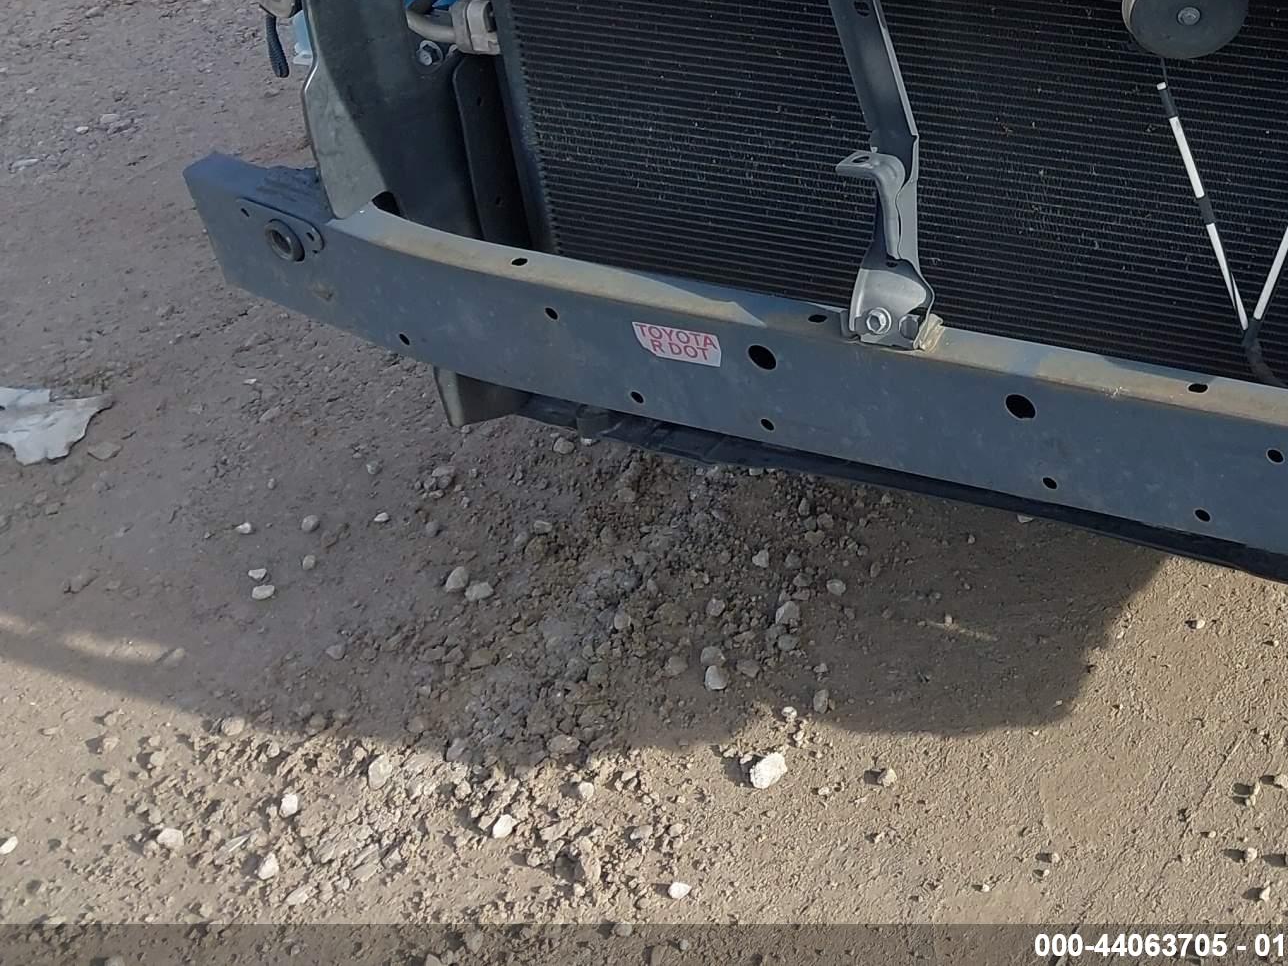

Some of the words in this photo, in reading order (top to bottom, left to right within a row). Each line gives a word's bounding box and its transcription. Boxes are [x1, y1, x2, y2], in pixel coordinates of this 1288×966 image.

[635, 323, 718, 350] TOYOTA
[650, 339, 666, 354] R
[668, 342, 709, 361] DOT
